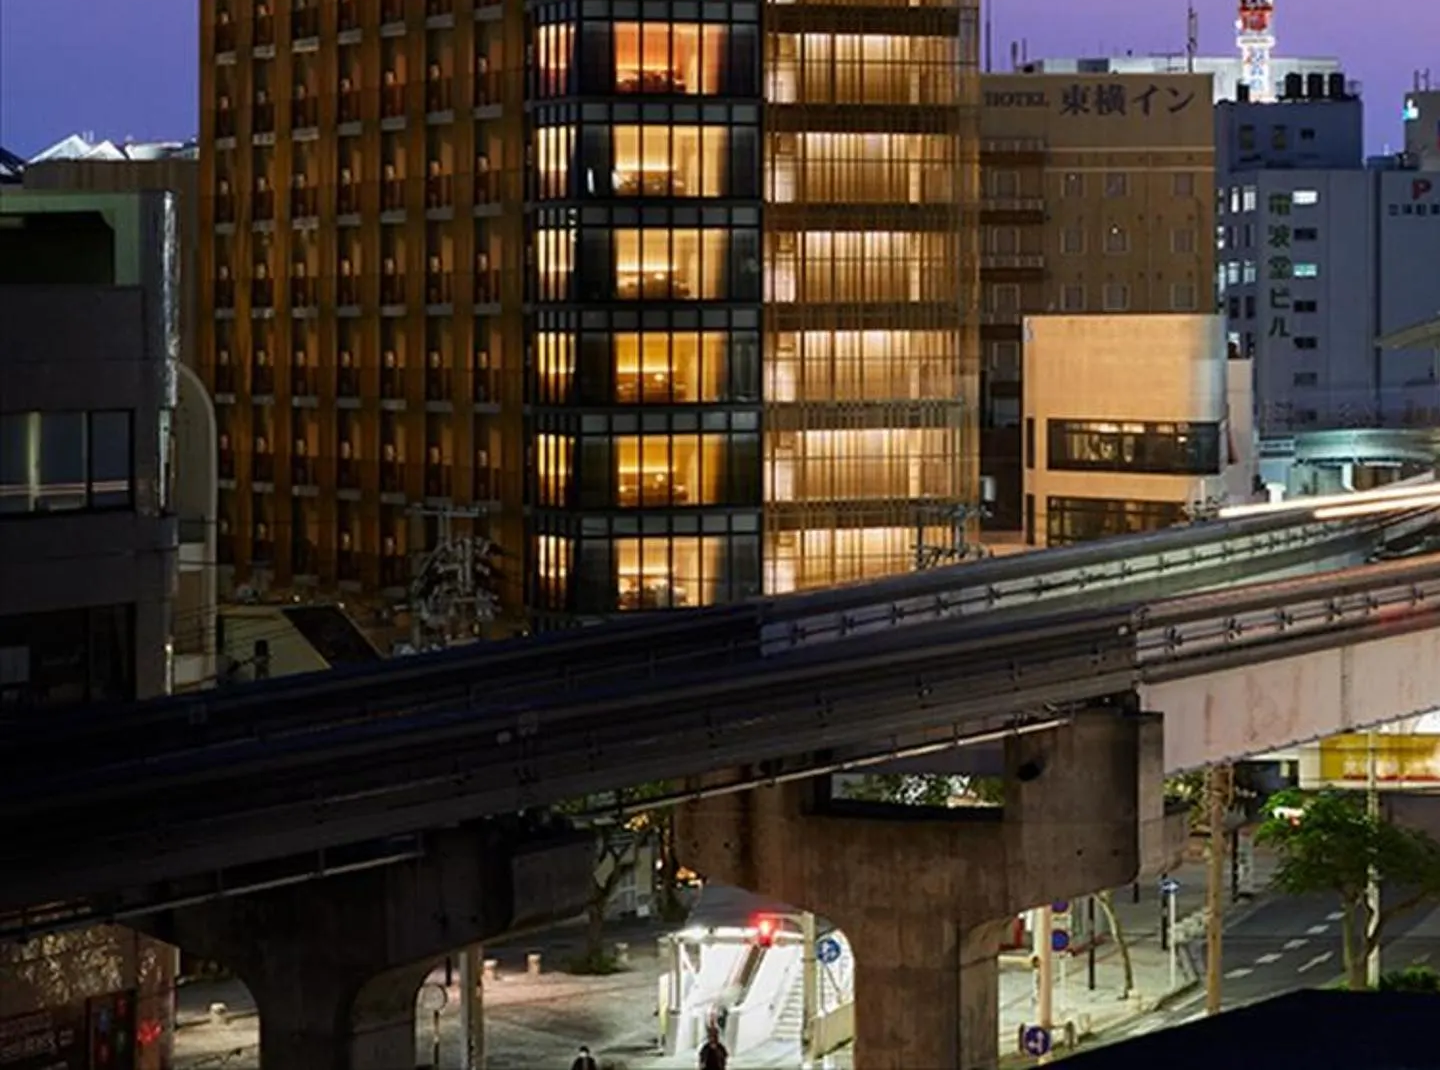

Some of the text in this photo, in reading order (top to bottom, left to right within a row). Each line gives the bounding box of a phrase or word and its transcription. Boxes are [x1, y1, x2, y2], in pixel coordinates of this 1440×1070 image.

[984, 84, 1195, 116] HOTEL 東横イン
[1412, 179, 1433, 201] P
